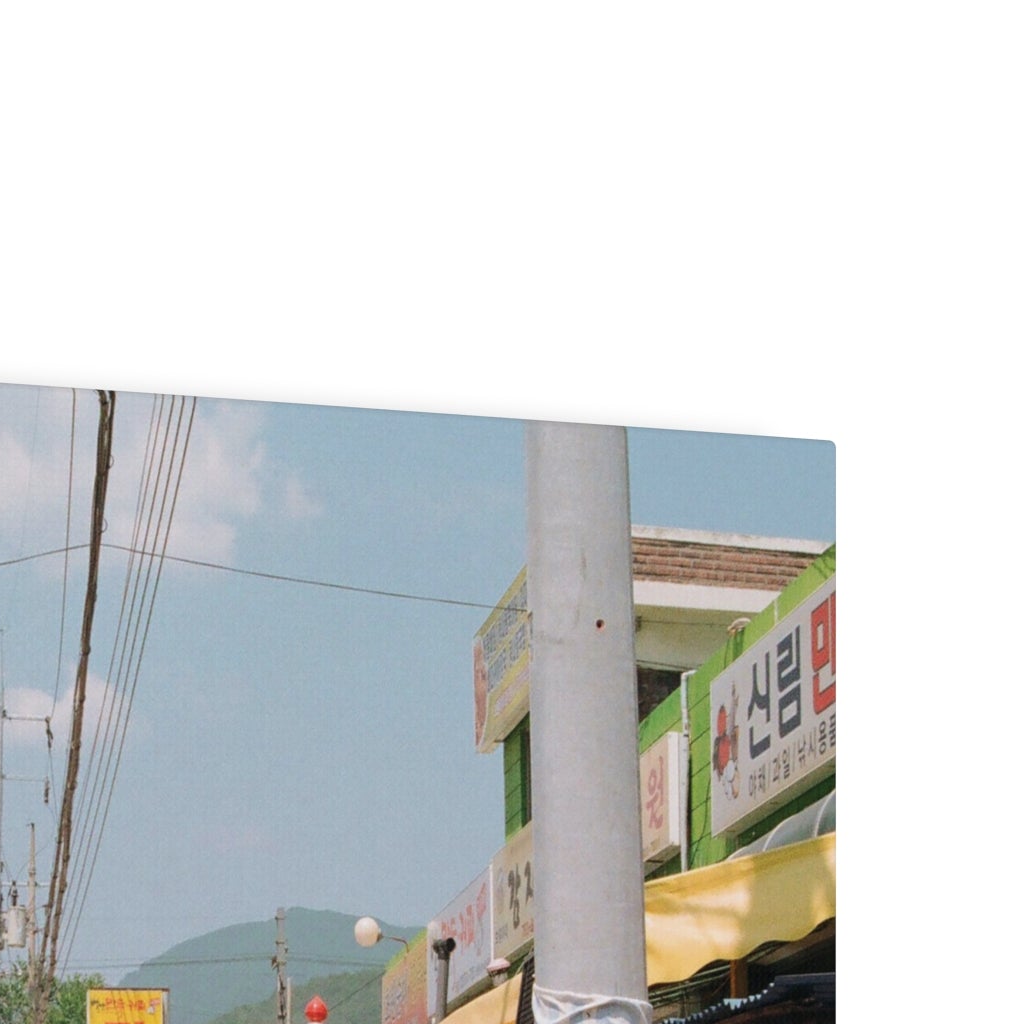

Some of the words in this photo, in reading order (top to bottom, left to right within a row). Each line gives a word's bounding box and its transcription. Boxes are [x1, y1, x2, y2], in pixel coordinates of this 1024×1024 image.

[747, 625, 802, 760] 신림
[748, 763, 766, 797] 야채
[772, 746, 790, 783] 과일
